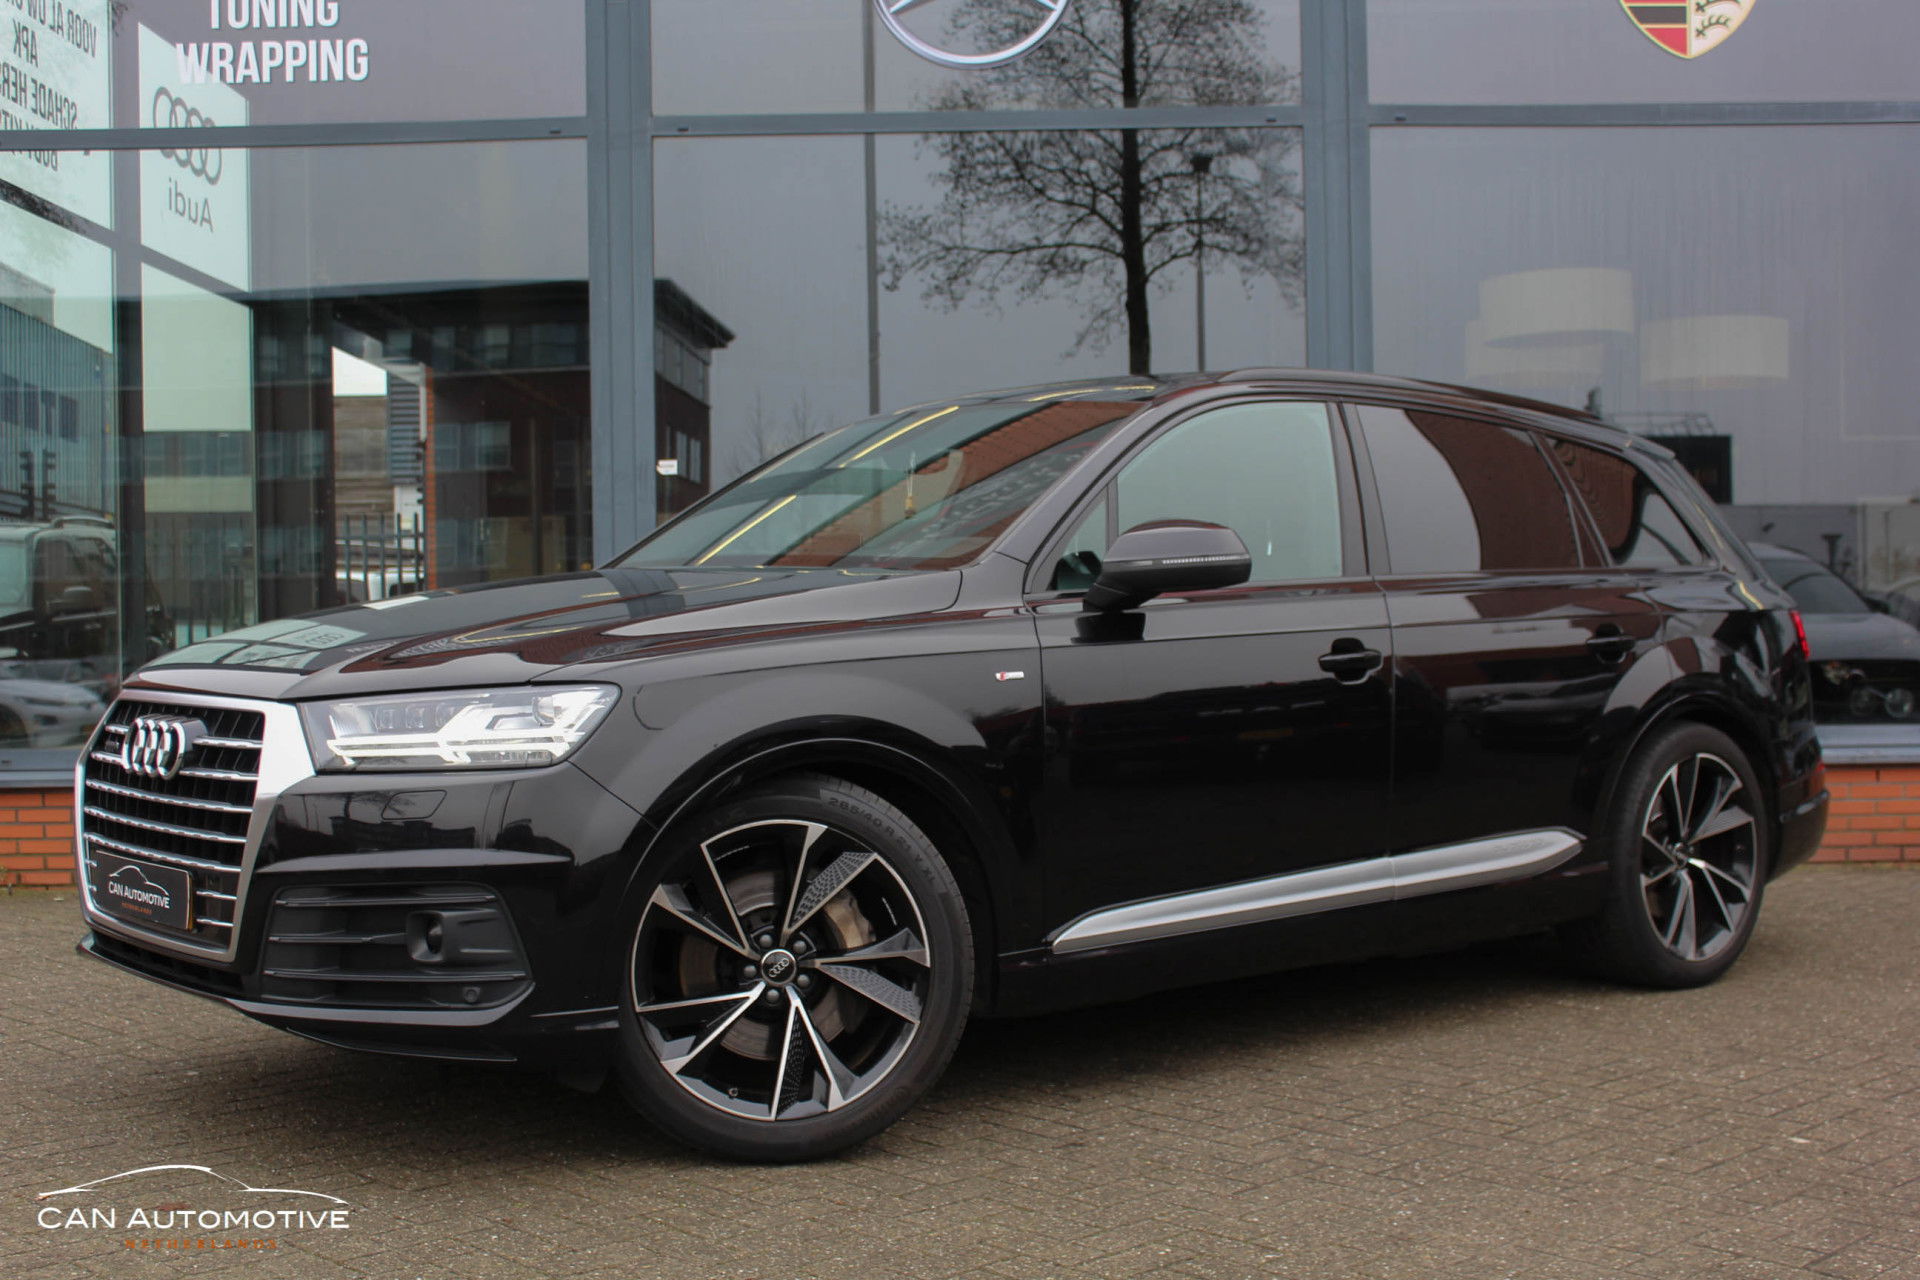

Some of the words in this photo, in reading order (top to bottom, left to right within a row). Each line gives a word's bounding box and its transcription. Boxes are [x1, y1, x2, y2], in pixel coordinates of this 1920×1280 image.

[210, 0, 339, 29] TUNING
[175, 38, 369, 84] WRAPPING
[108, 881, 124, 896] CAN
[123, 886, 170, 909] AUTOMOTIVE
